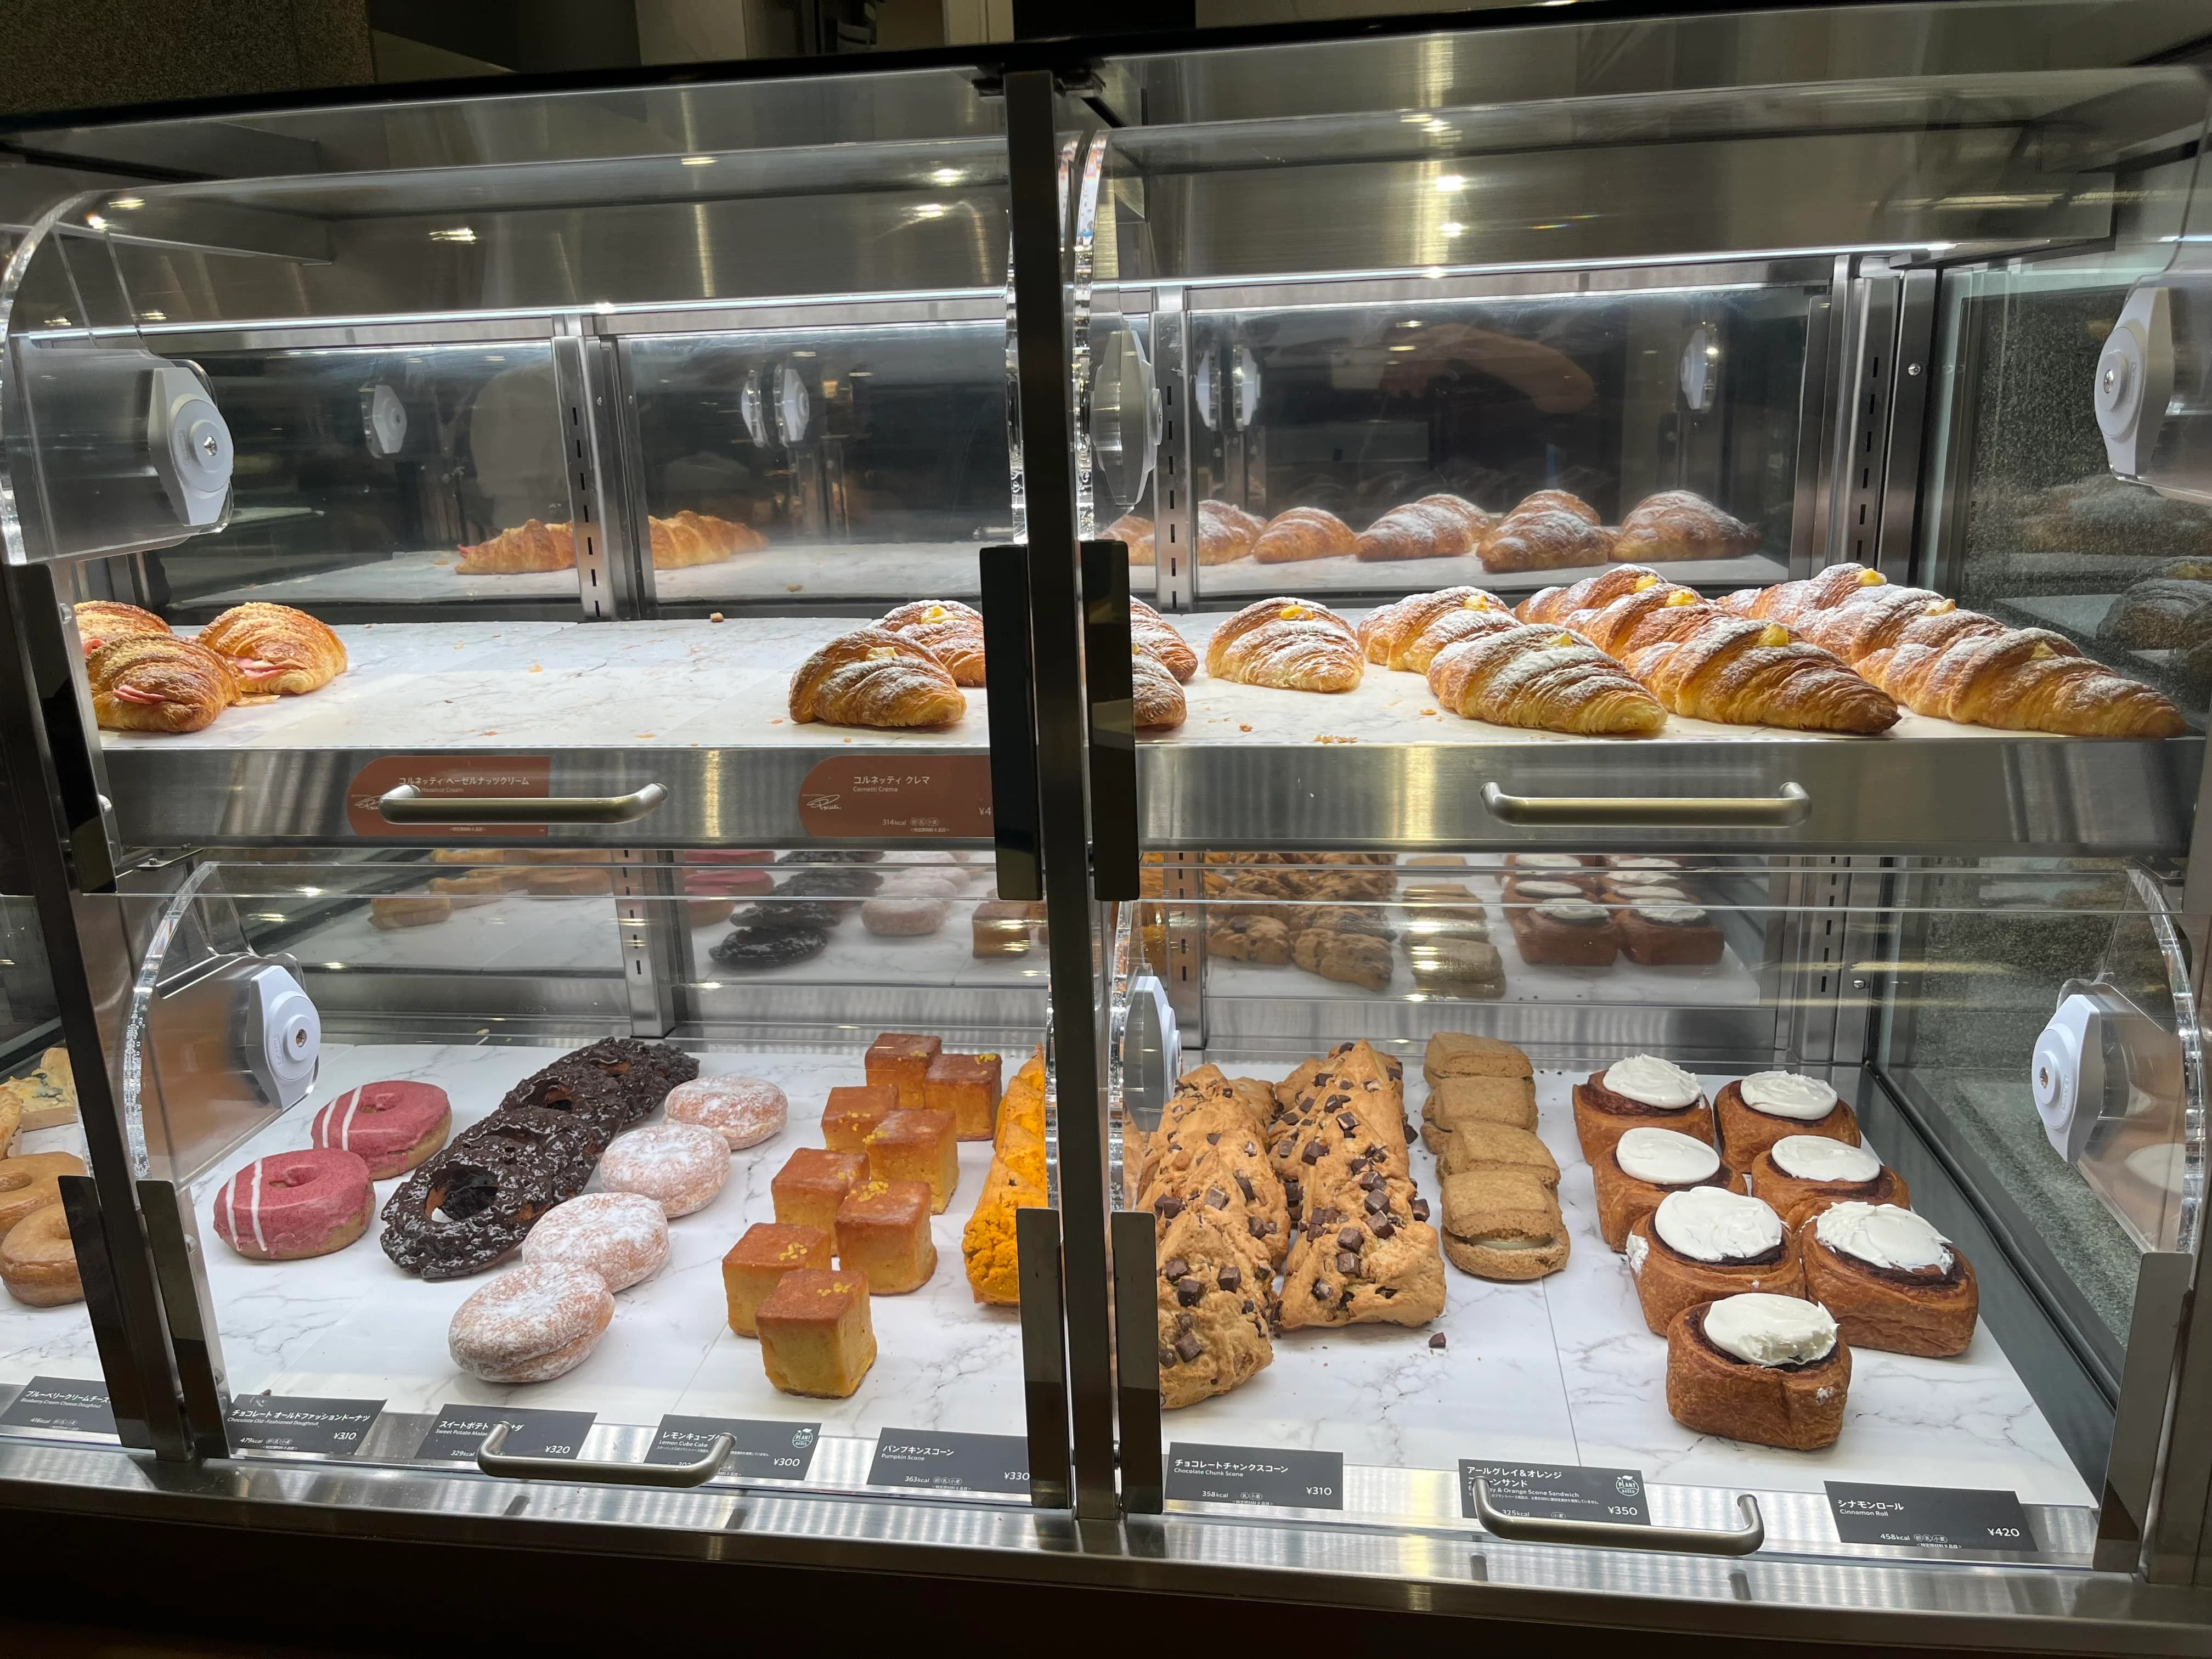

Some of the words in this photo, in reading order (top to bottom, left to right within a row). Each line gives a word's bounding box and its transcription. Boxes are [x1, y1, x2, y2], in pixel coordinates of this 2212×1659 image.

[446, 777, 529, 786] ヘーゼルナッツクリーム
[853, 775, 900, 785] コルネッティ
[906, 776, 930, 785] クレマ
[979, 807, 992, 816] ¥4
[26, 1391, 111, 1404] ブルーベリークリームチーズ
[274, 1412, 370, 1422] オールドファッションドーナツ
[439, 1420, 489, 1430] スイートポテト
[334, 1432, 357, 1440] ¥310
[545, 1446, 570, 1454] ¥320
[883, 1445, 954, 1455] パンプキンスコーン
[774, 1458, 800, 1466] ¥300
[1175, 1459, 1289, 1473] チョコレートチャンクスコーン
[1005, 1472, 1030, 1480] ¥330
[1306, 1487, 1331, 1496] ¥310
[1838, 1499, 1904, 1510] シナモンロール
[1607, 1506, 1637, 1515] ¥350
[1987, 1527, 2019, 1537] ¥420
